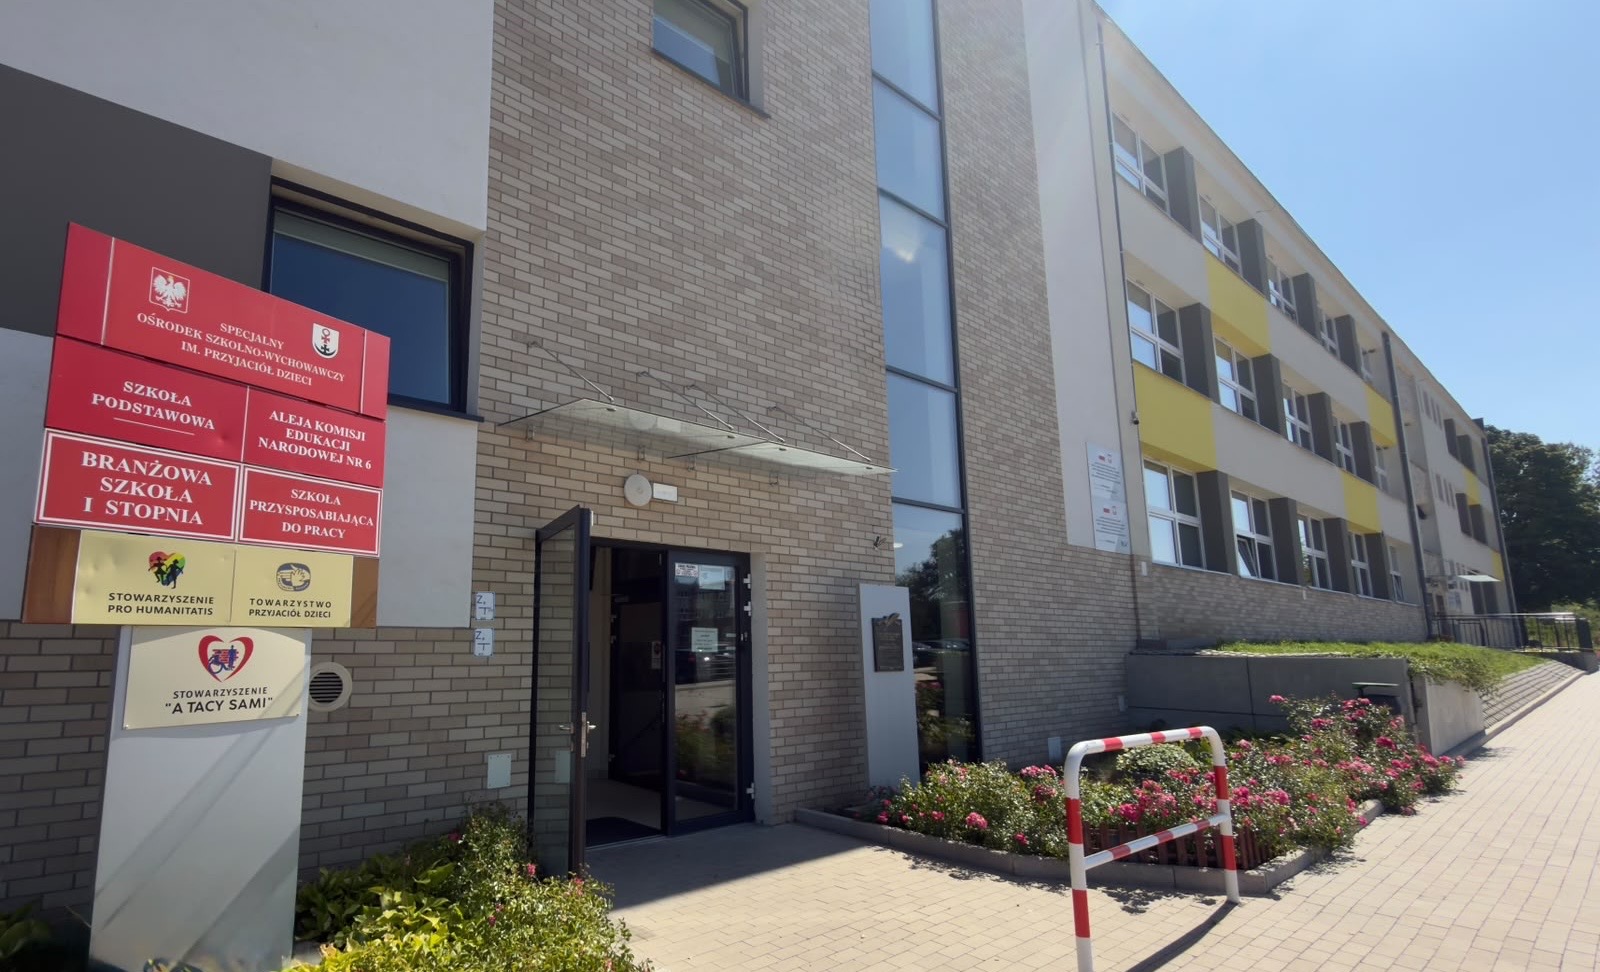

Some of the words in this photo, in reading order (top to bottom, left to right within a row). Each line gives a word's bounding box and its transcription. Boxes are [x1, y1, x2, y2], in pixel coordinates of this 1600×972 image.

[137, 312, 202, 340] OŚRODEK
[205, 333, 345, 382] SZKOLNO-WYCHOWAWCZY
[220, 322, 284, 350] SPECJALNY
[181, 340, 200, 355] IM.
[204, 348, 274, 376] PRZYJACIÓŁ
[277, 368, 312, 386] DZIECI
[123, 380, 192, 407] SZKOŁA
[91, 393, 215, 430] PODSTAWOWA
[269, 410, 312, 429] ALEJA
[315, 420, 366, 442] KOMISJI
[258, 436, 344, 464] NARODOWEJ
[346, 455, 363, 468] NR
[365, 460, 372, 470] 6
[286, 428, 351, 452] EDUKACJI
[81, 451, 212, 486] BRANŻOWA
[100, 476, 193, 503] SZKOŁA
[290, 488, 341, 506] SZKOŁA
[83, 496, 93, 513] I
[105, 499, 203, 525] STOPNIA
[249, 499, 374, 527] PRZYSPOSABIAJĄCA
[281, 521, 301, 534] DO
[304, 524, 346, 539] PRACY
[108, 592, 214, 605] STOWARZYSZENIE
[108, 604, 132, 614] PRO
[136, 605, 213, 616] HUMANITATIS
[249, 598, 332, 609] TOWARZYSTWO
[248, 608, 301, 618] PRZYJACIÓŁ
[304, 610, 331, 618] DZIECI
[165, 702, 183, 715] "A
[187, 700, 225, 713] TACY
[228, 697, 273, 711] SAMI"
[173, 686, 268, 700] STOWARZYSZENIE
